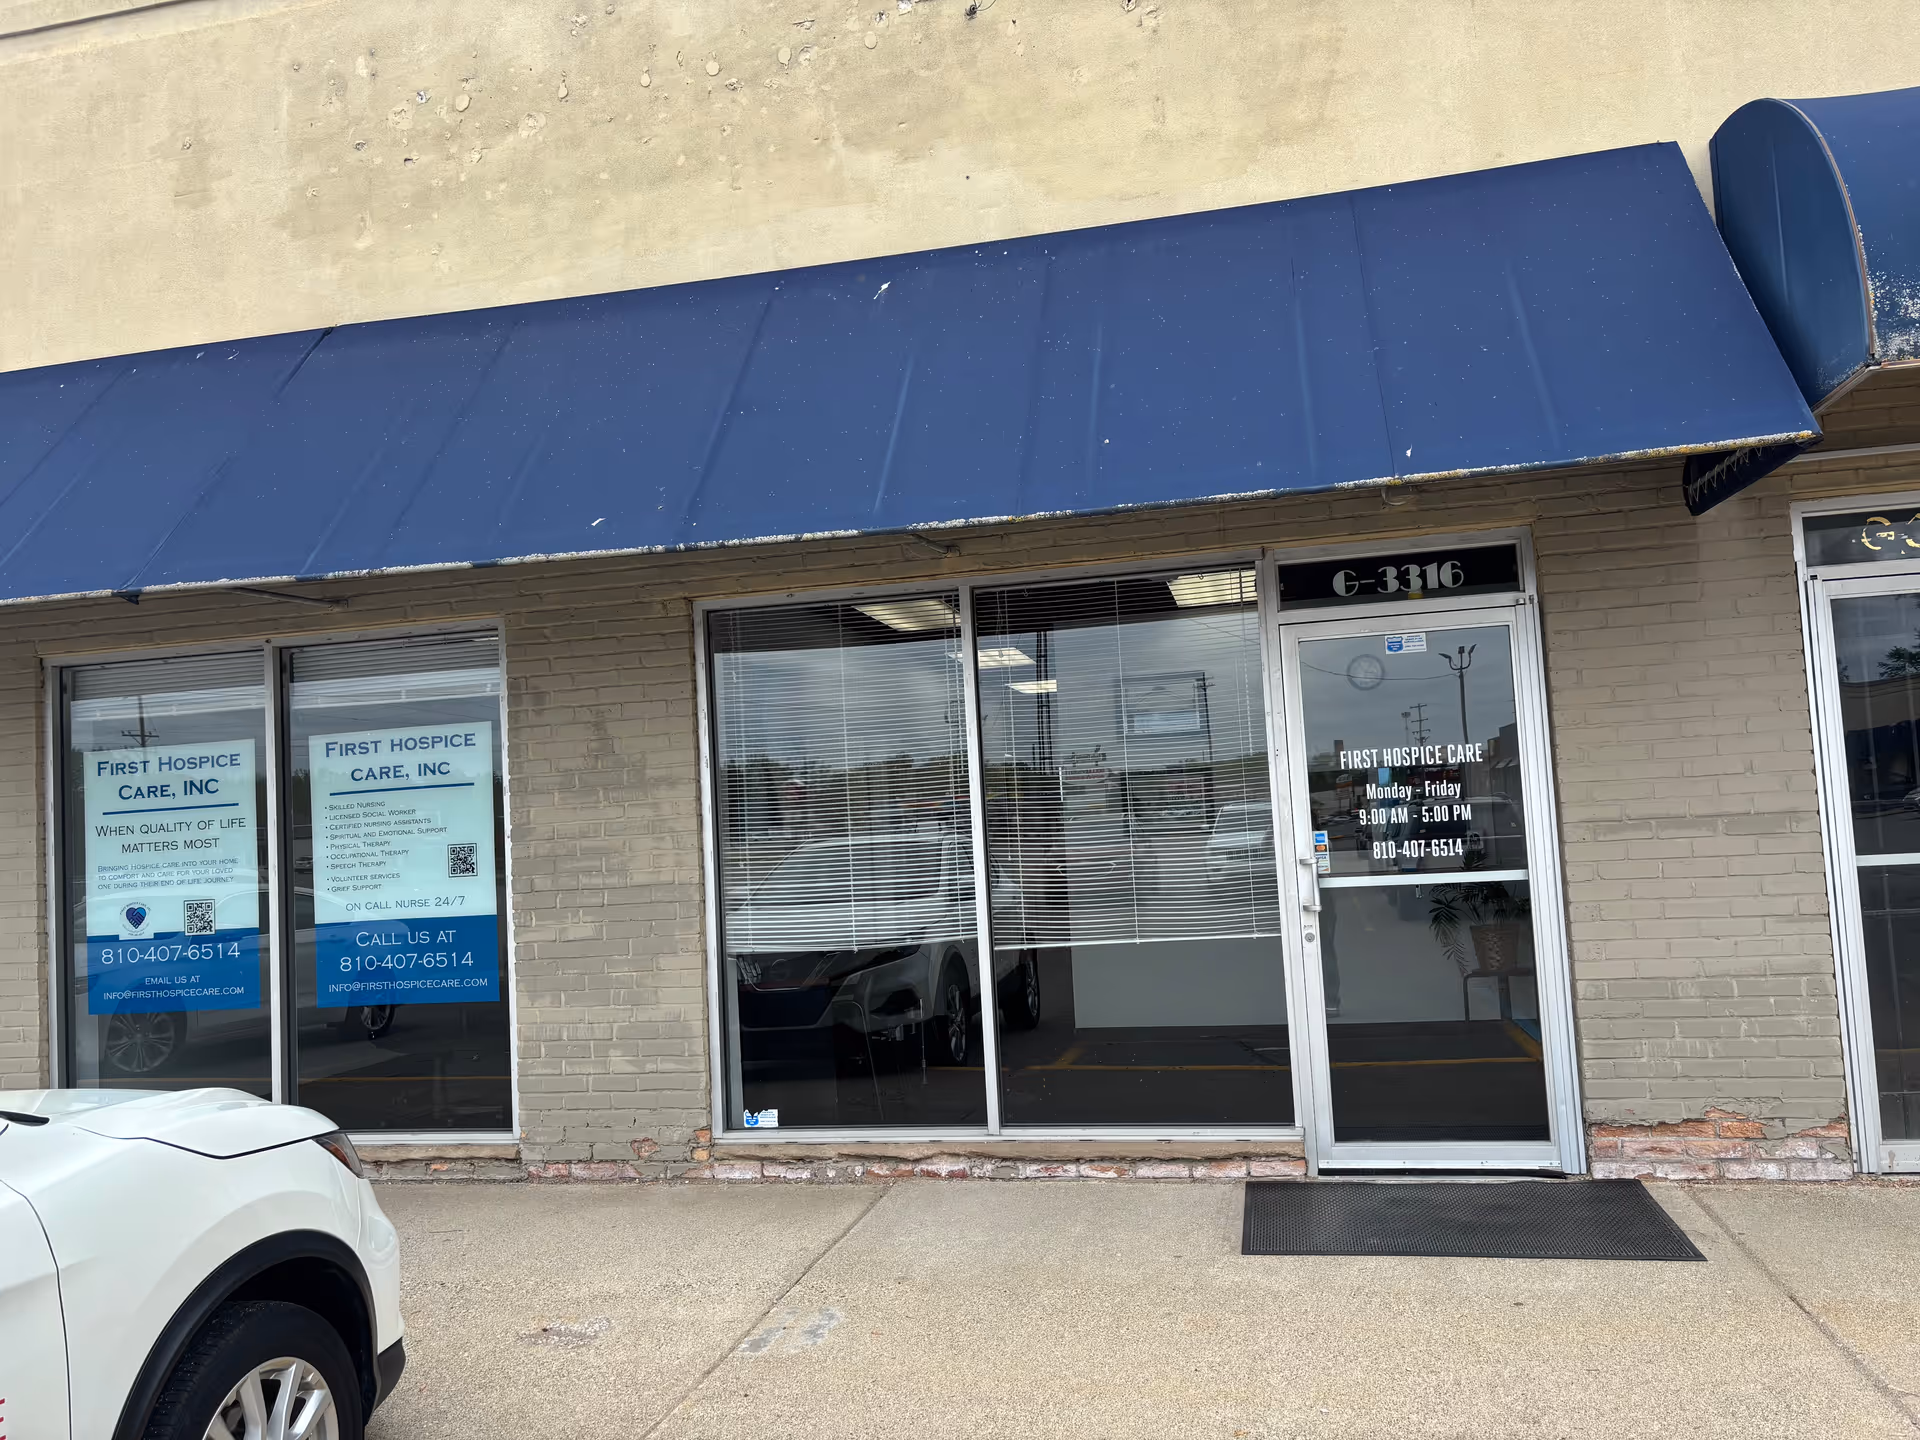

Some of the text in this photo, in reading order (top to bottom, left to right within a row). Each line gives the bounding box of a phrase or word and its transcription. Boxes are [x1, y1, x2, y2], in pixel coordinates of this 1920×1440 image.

[1332, 560, 1465, 597] G-3316
[325, 732, 476, 758] FIRST HOSPICE
[1339, 742, 1483, 770] FIRST HOSPICE CARE
[97, 753, 241, 777] FIRST HOSPICE
[350, 761, 451, 782] CARE, INC
[118, 778, 220, 800] CARE, INC
[1366, 782, 1412, 802] Monday
[1424, 779, 1461, 799] Friday
[328, 801, 386, 811] SKILLED NURSING
[1359, 808, 1386, 825] 9:00
[1390, 807, 1409, 824] AM
[1421, 805, 1449, 823] 5:00
[1453, 803, 1472, 821] PM
[329, 808, 417, 821] LICENSED SOCIAL WORKER
[95, 817, 246, 837] WHEN QUALITY OF LIFE
[329, 818, 432, 831] CERTIFIED NURSING ASSISTANTS
[329, 832, 361, 841] SPIRITUAL
[378, 829, 415, 837] EMOTIONAL
[417, 826, 447, 835] SUPPORT
[121, 837, 220, 854] MATTERS MOST
[330, 840, 391, 851] PHYSICAL THERAPY
[1373, 838, 1464, 860] 810-407-6514
[330, 849, 410, 860] OCCUPATIONAL THERAPY
[97, 865, 129, 873] BRINGING
[130, 863, 160, 871] HOSPICE
[162, 861, 180, 869] CARE
[181, 860, 197, 868] INTO
[199, 859, 217, 867] YOUR
[330, 860, 387, 870] SPEECH THERAPY
[108, 873, 139, 881] COMFORT
[211, 867, 233, 875] LOVED
[160, 879, 174, 887] END
[203, 876, 234, 884] JOURNEY
[331, 875, 368, 883] VOLUNTEER
[331, 883, 382, 893] GRIEF SUPPORT
[345, 895, 466, 912] ON CALL NURSE 24/7
[355, 929, 457, 947] CALL US AT
[101, 942, 241, 965] 810-407-6514
[339, 951, 474, 972] 810-407-6514
[145, 975, 201, 985] EMAIL US AT
[328, 977, 488, 993] INFO@FIRSTHOSPICECARE.COM
[103, 986, 245, 1000] INFO@FIRSTHOSPICECARE.COM
